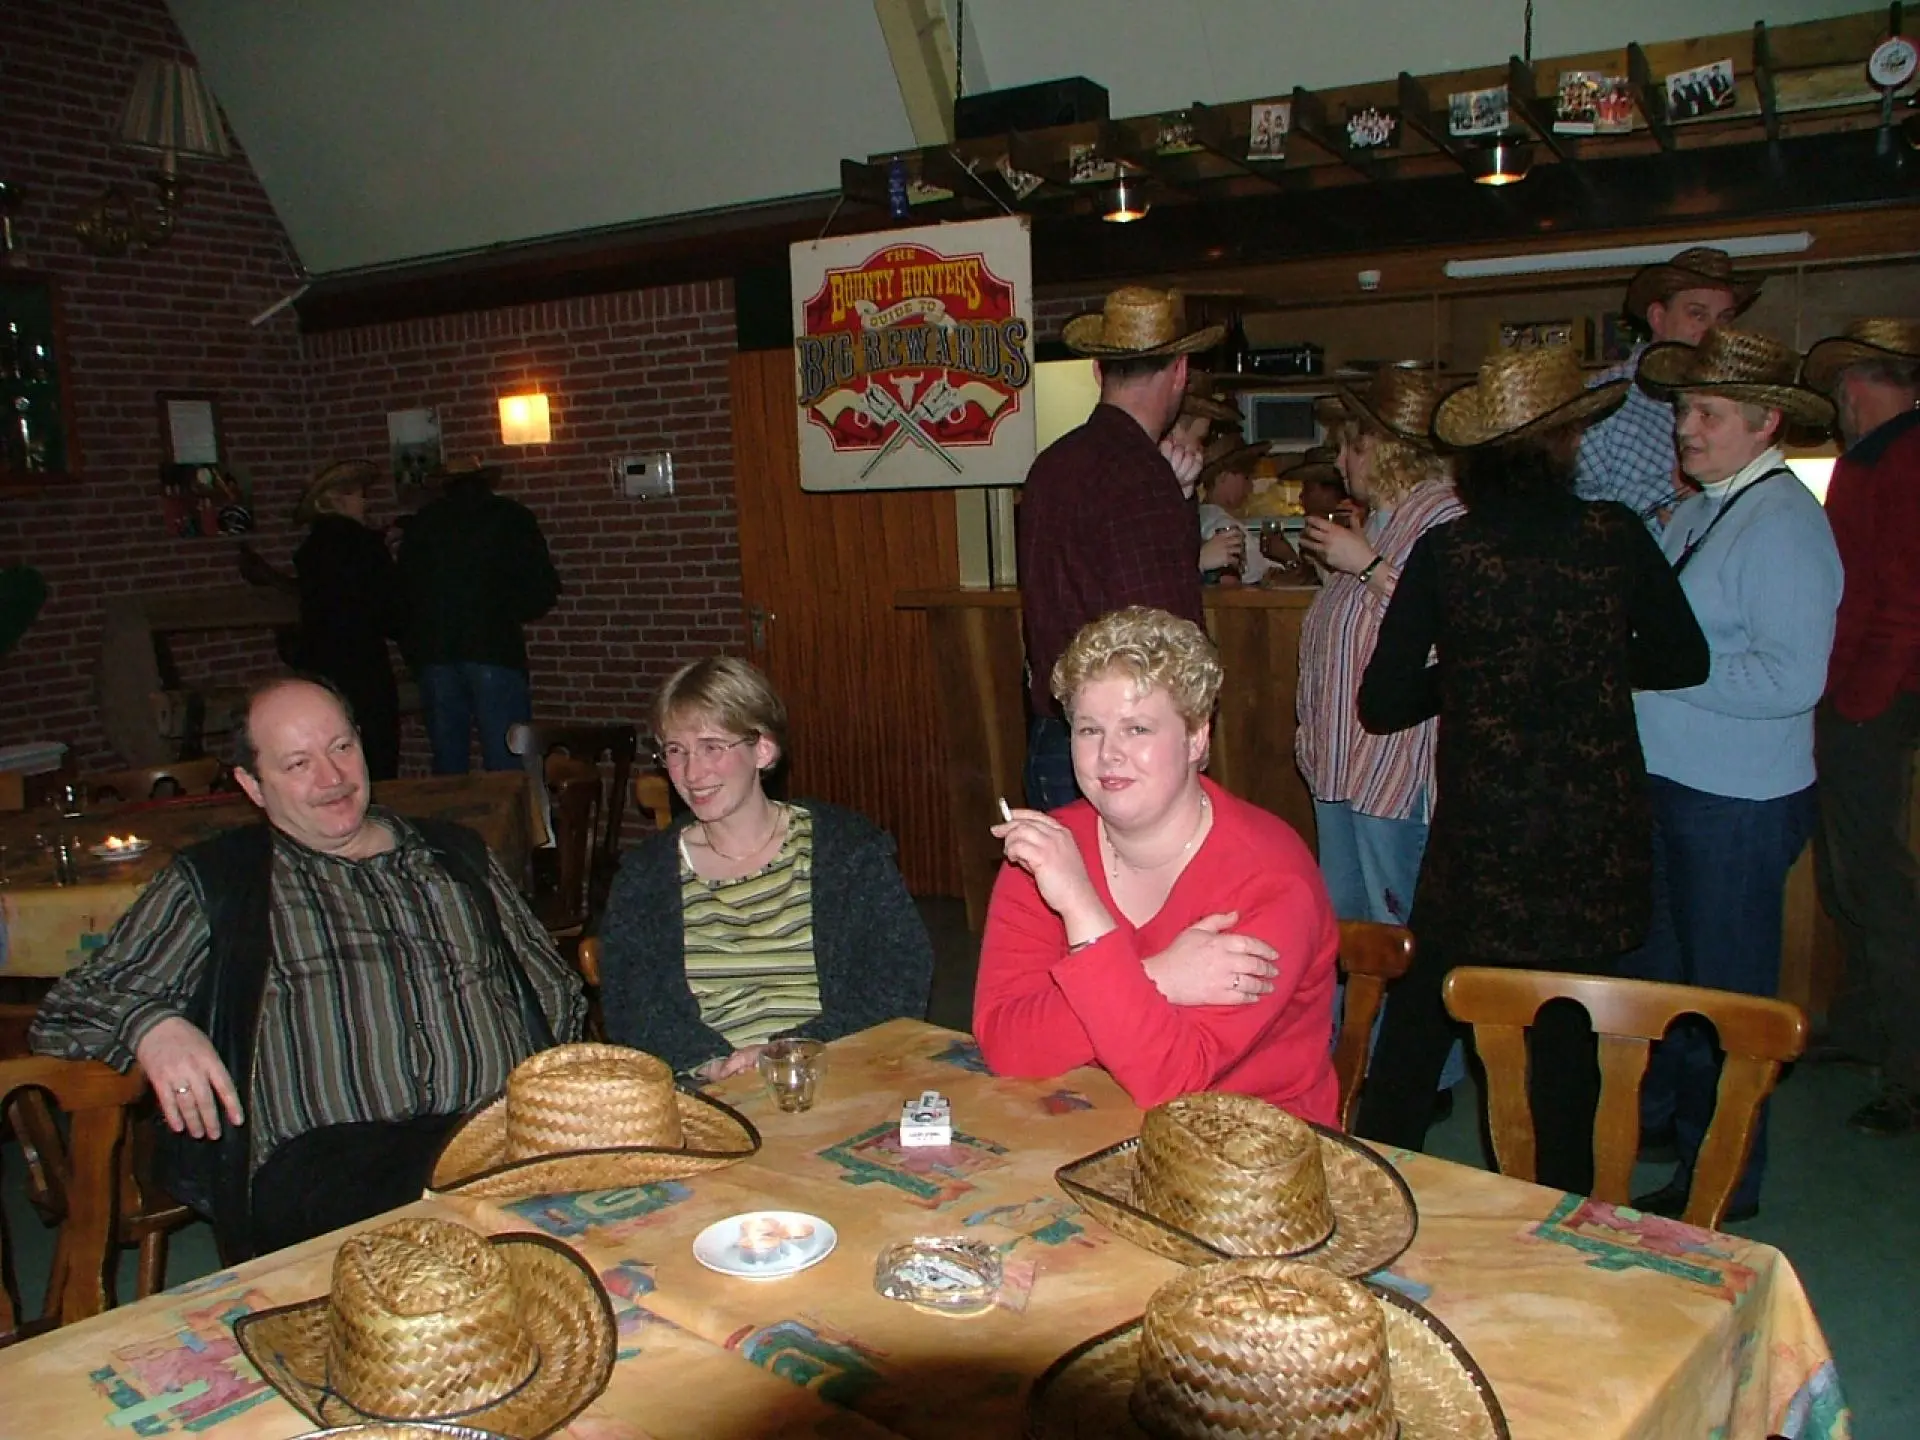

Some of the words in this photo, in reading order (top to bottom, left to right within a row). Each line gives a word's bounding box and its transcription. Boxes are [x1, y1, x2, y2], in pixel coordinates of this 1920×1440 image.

[885, 249, 915, 262] THE
[829, 269, 895, 324] BOUNTY
[869, 303, 913, 326] GUIDE
[919, 300, 937, 313] TO
[798, 334, 854, 402] BIG
[862, 319, 1030, 388] REWARDS
